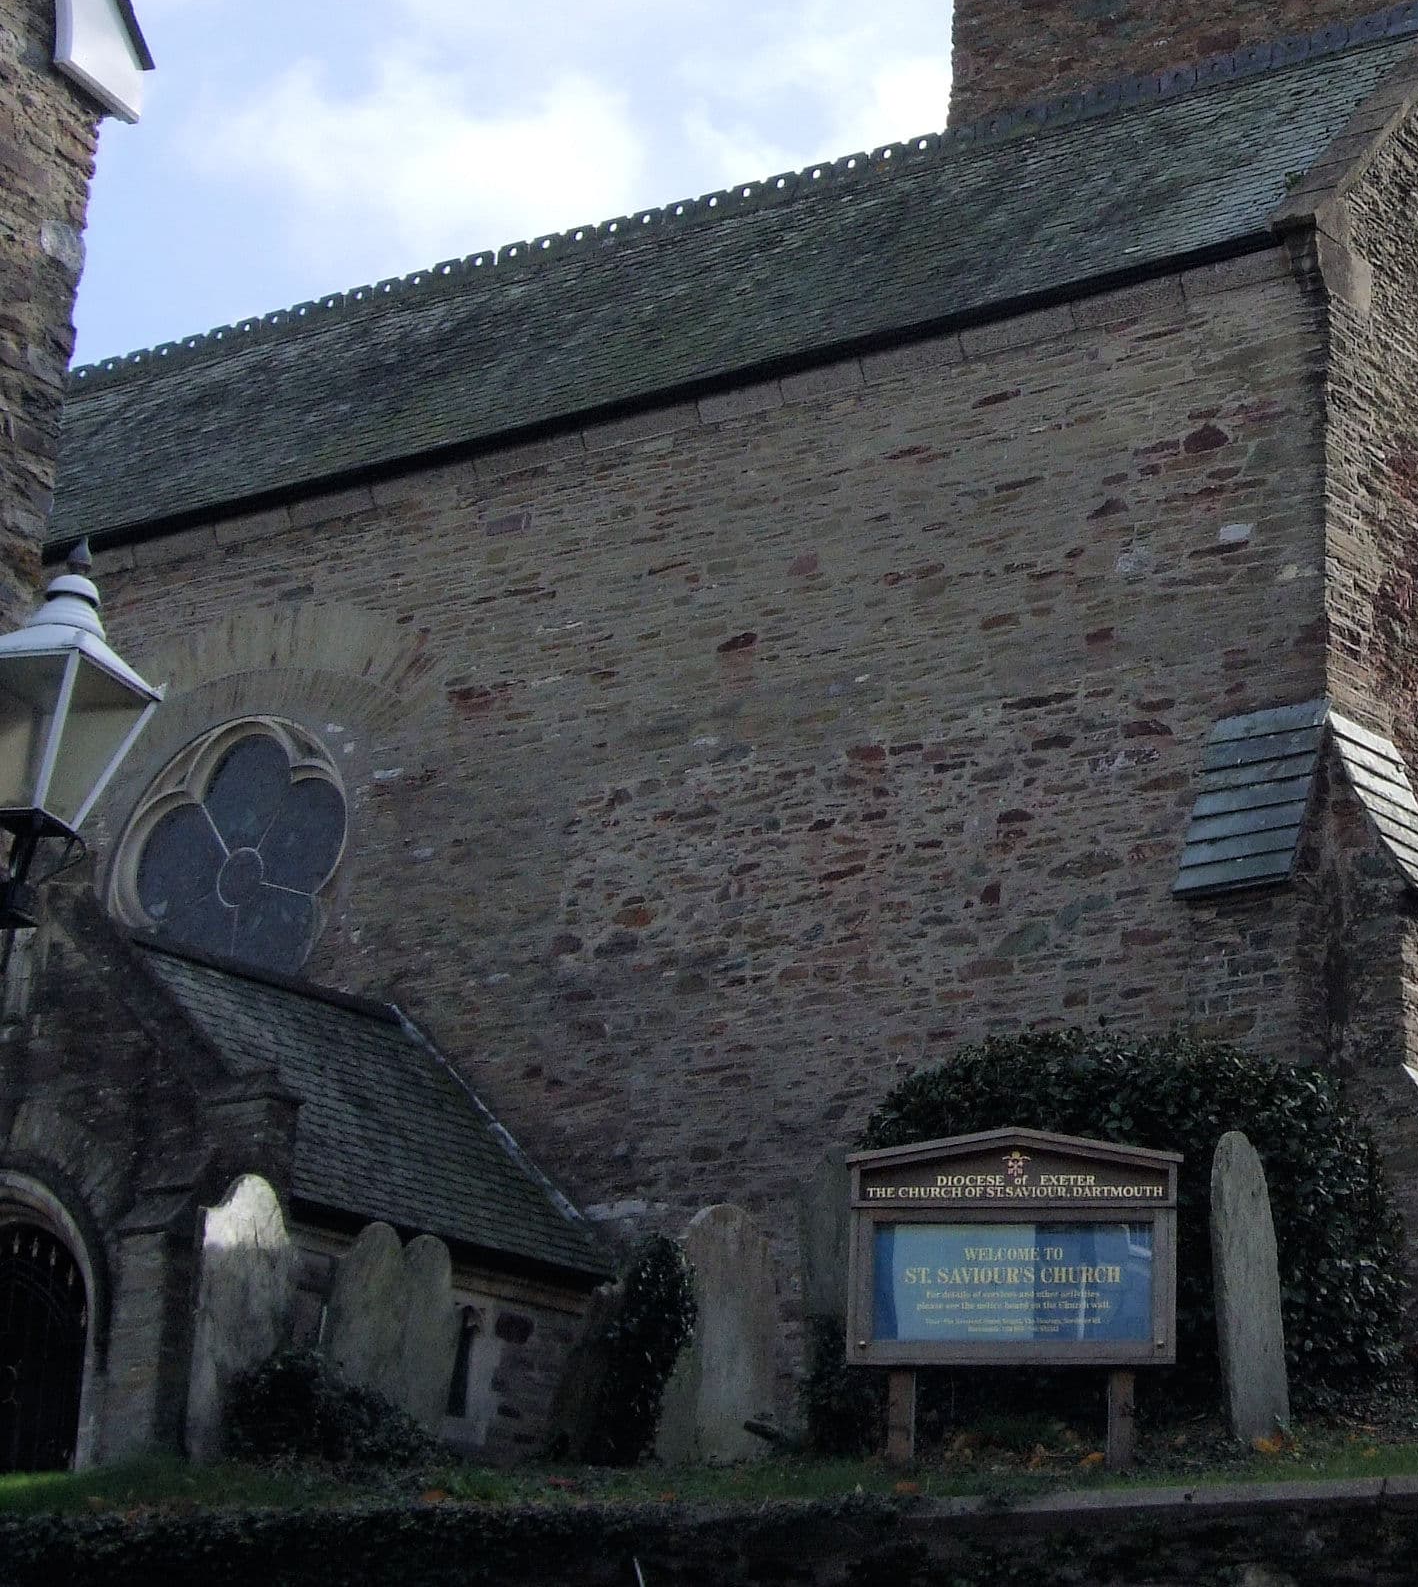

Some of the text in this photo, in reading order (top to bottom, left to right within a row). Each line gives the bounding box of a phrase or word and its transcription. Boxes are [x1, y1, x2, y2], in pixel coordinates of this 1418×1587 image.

[937, 1174, 1096, 1187] DIOCESE of EXETER
[867, 1186, 896, 1198] THE
[898, 1186, 961, 1198] CHURCH
[965, 1186, 984, 1198] OF
[1073, 1186, 1163, 1197] DARTMOUTH
[964, 1246, 1064, 1261] WELCOME TO
[937, 1267, 1036, 1284] SAVIOUR'S
[1040, 1266, 1121, 1284] CHURCH
